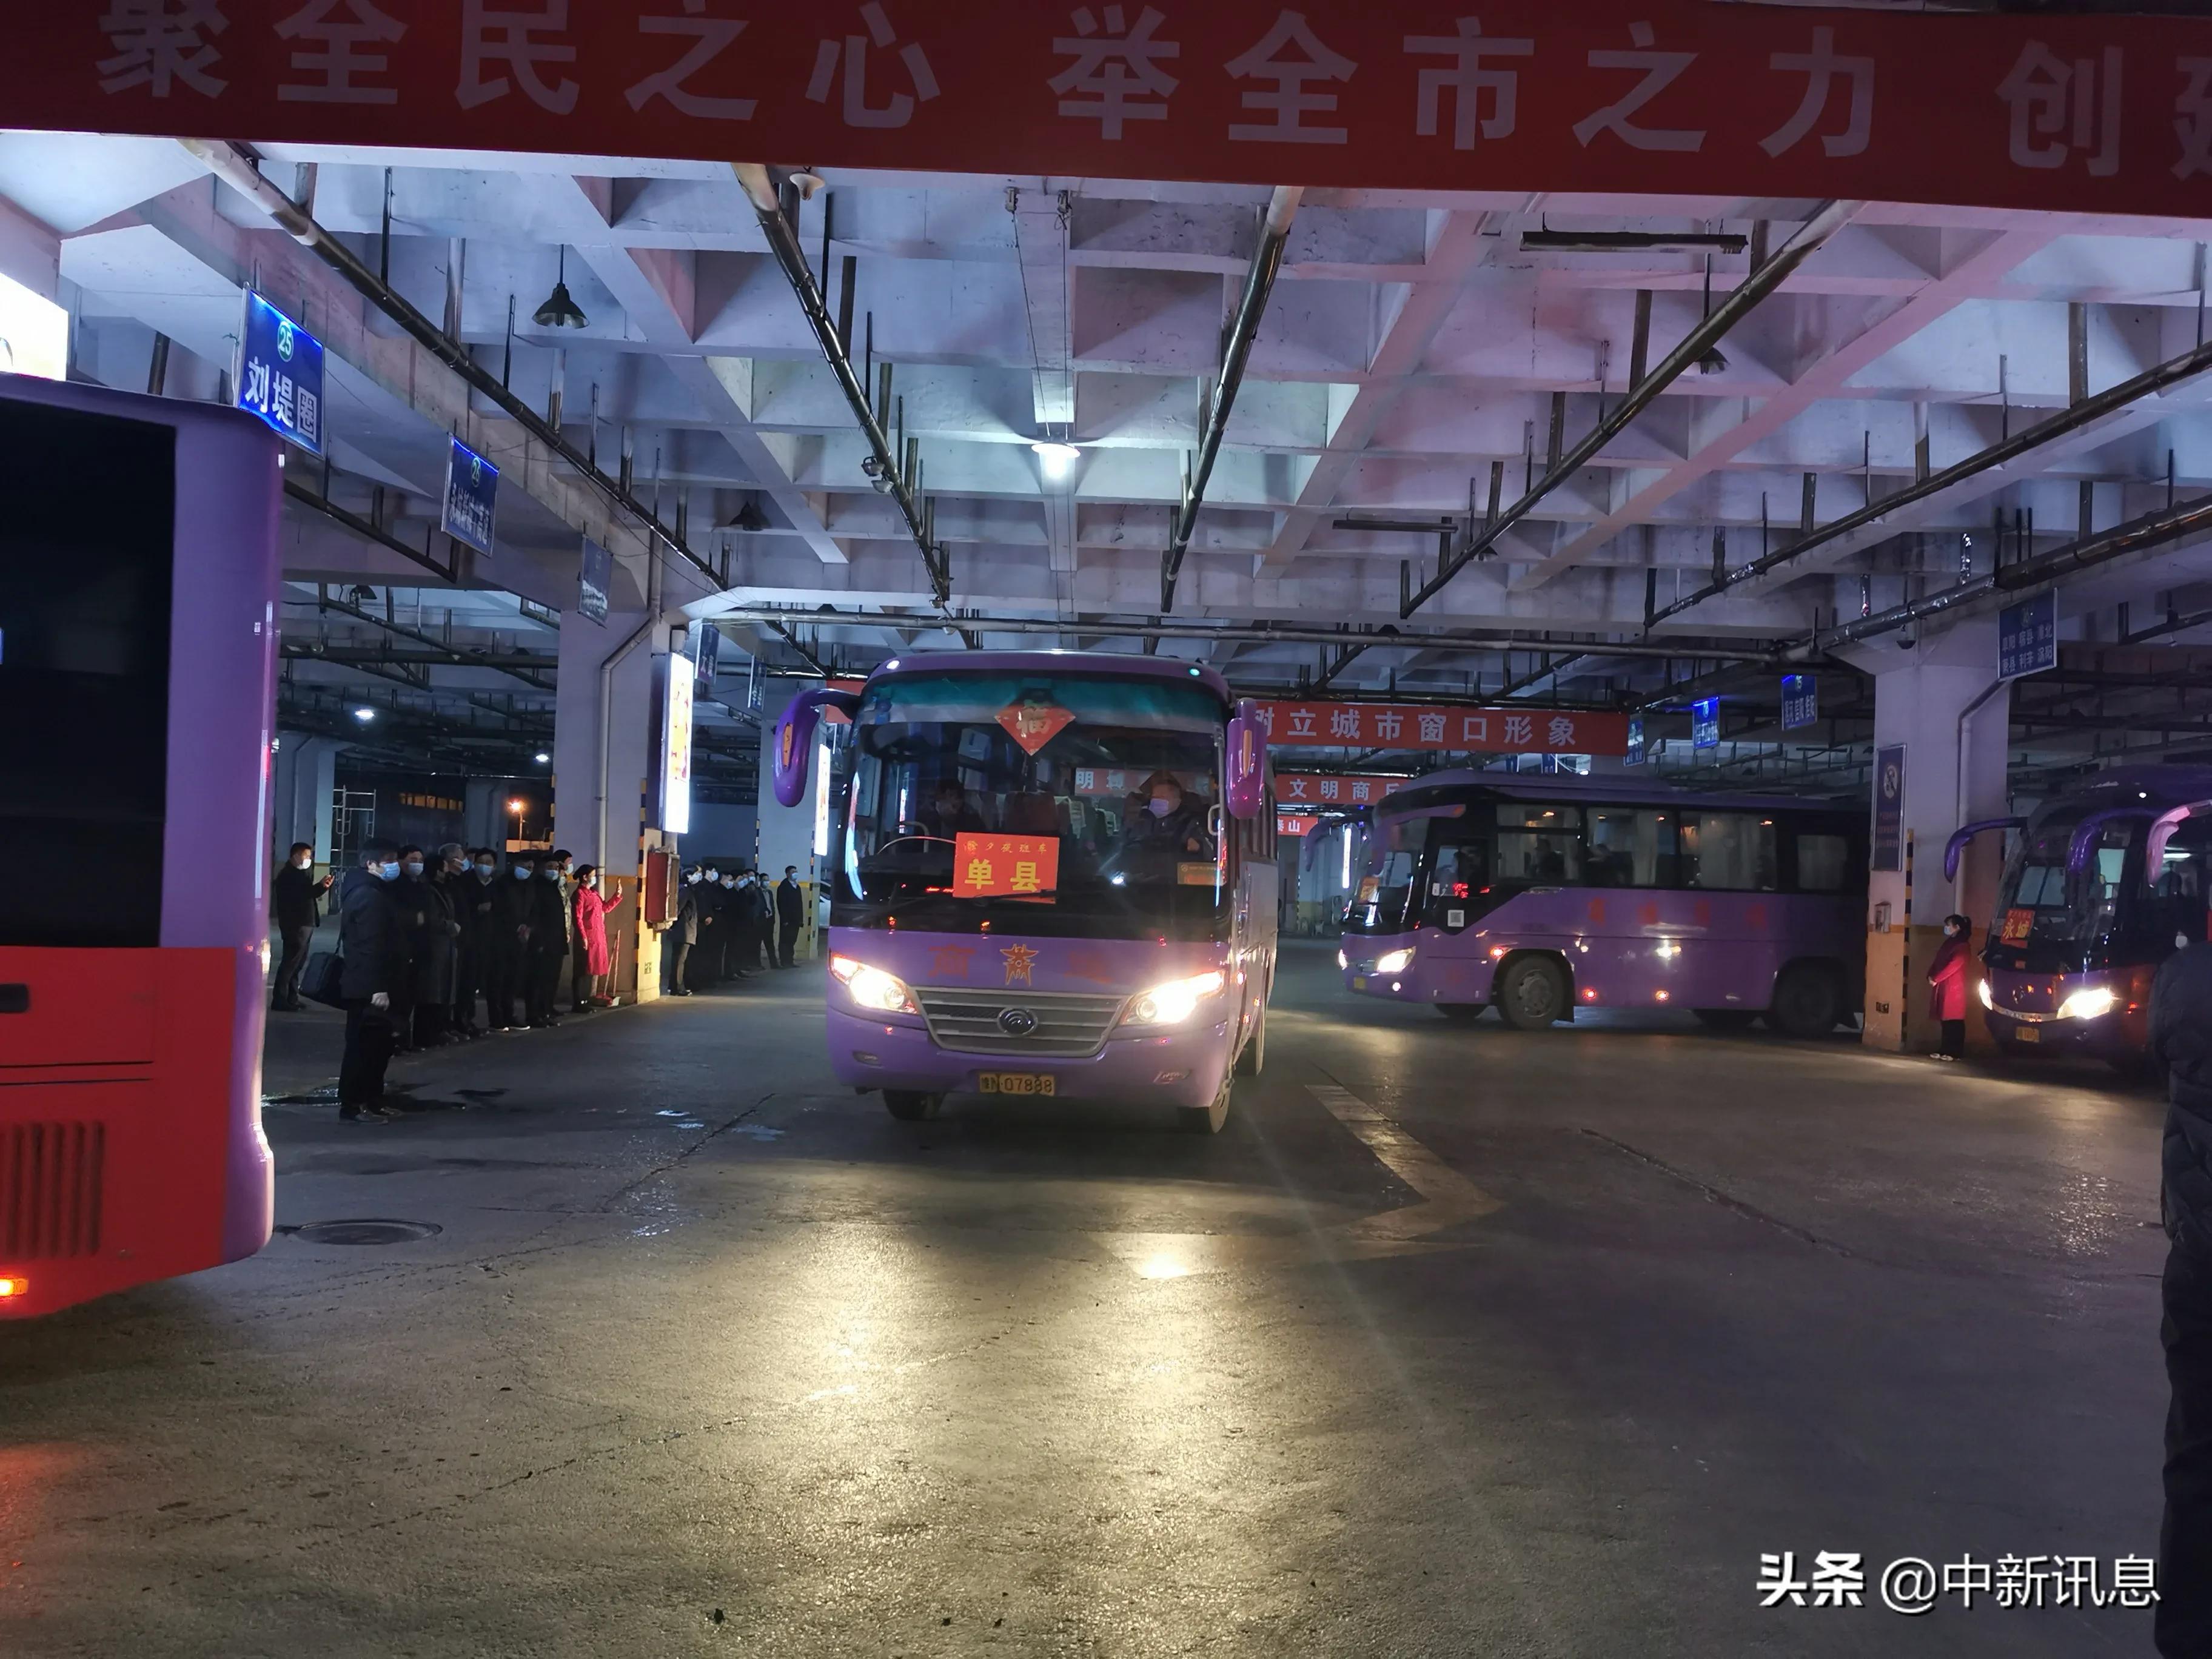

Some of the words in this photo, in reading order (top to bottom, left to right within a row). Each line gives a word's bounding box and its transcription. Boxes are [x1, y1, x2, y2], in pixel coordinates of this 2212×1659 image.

[96, 0, 940, 128] 聚全民之心
[1047, 4, 1875, 158] 举全市之力
[278, 327, 293, 357] 25
[244, 356, 318, 443] 刘堤圈
[964, 858, 1041, 892] 单县
